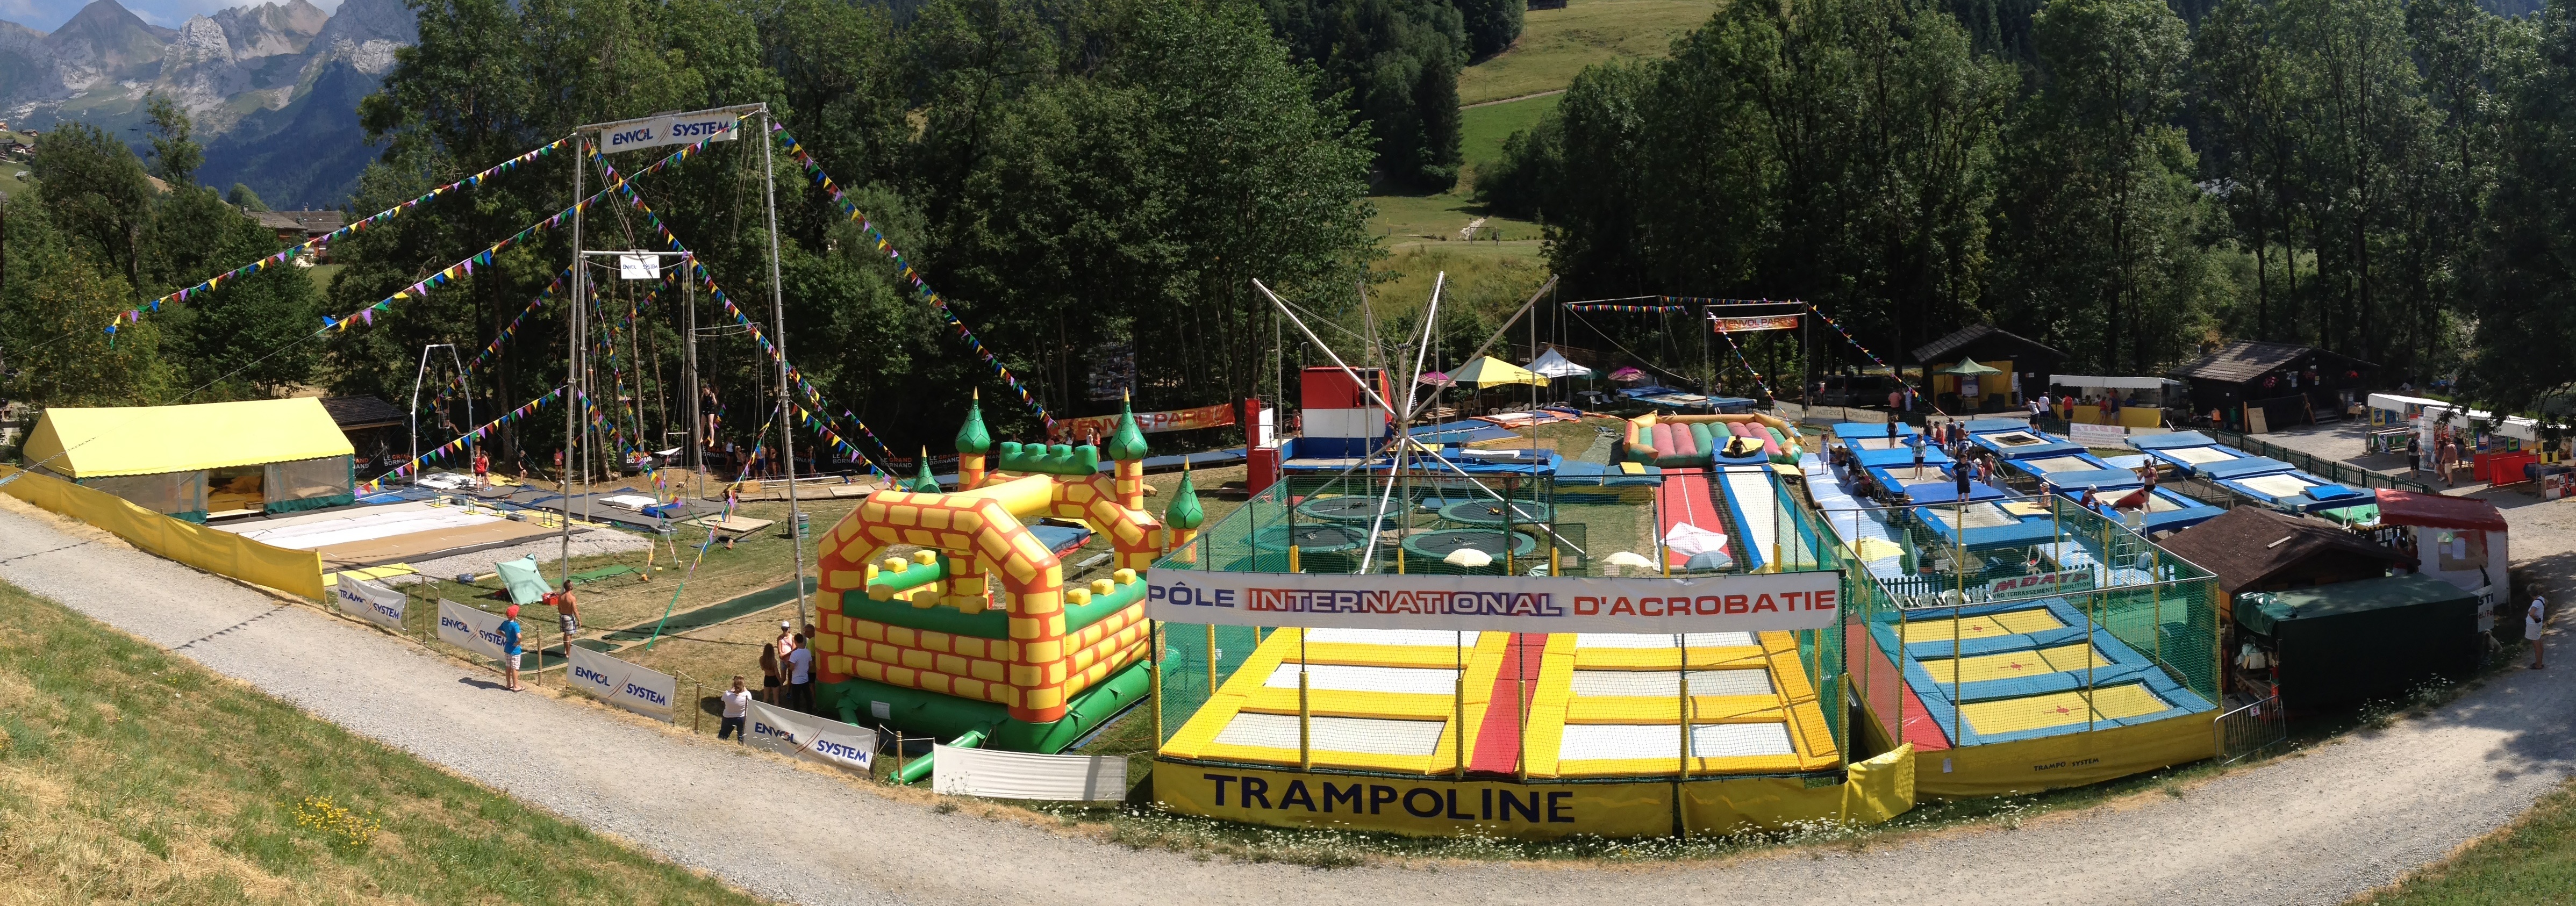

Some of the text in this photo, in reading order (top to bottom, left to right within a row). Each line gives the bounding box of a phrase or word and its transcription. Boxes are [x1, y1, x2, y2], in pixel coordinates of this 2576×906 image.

[612, 120, 730, 145] ENVOL SYSTEM
[1728, 319, 1759, 327] ENVOL
[1077, 415, 1150, 432] ENVL
[1148, 581, 1836, 617] PÔLE INTERNATIONAL D'ACROBATIE
[2007, 587, 2053, 596] TERRASSEMENT
[373, 602, 399, 619] SYSTEM
[441, 616, 506, 647] ENVOL SYSTEM
[575, 666, 666, 706] ENVOL SYSTEM
[755, 722, 867, 763] ENVOL SYSTEM
[2034, 757, 2099, 771] TRAMPO SYSTEM
[1203, 773, 1576, 823] TRAMPOLINE
